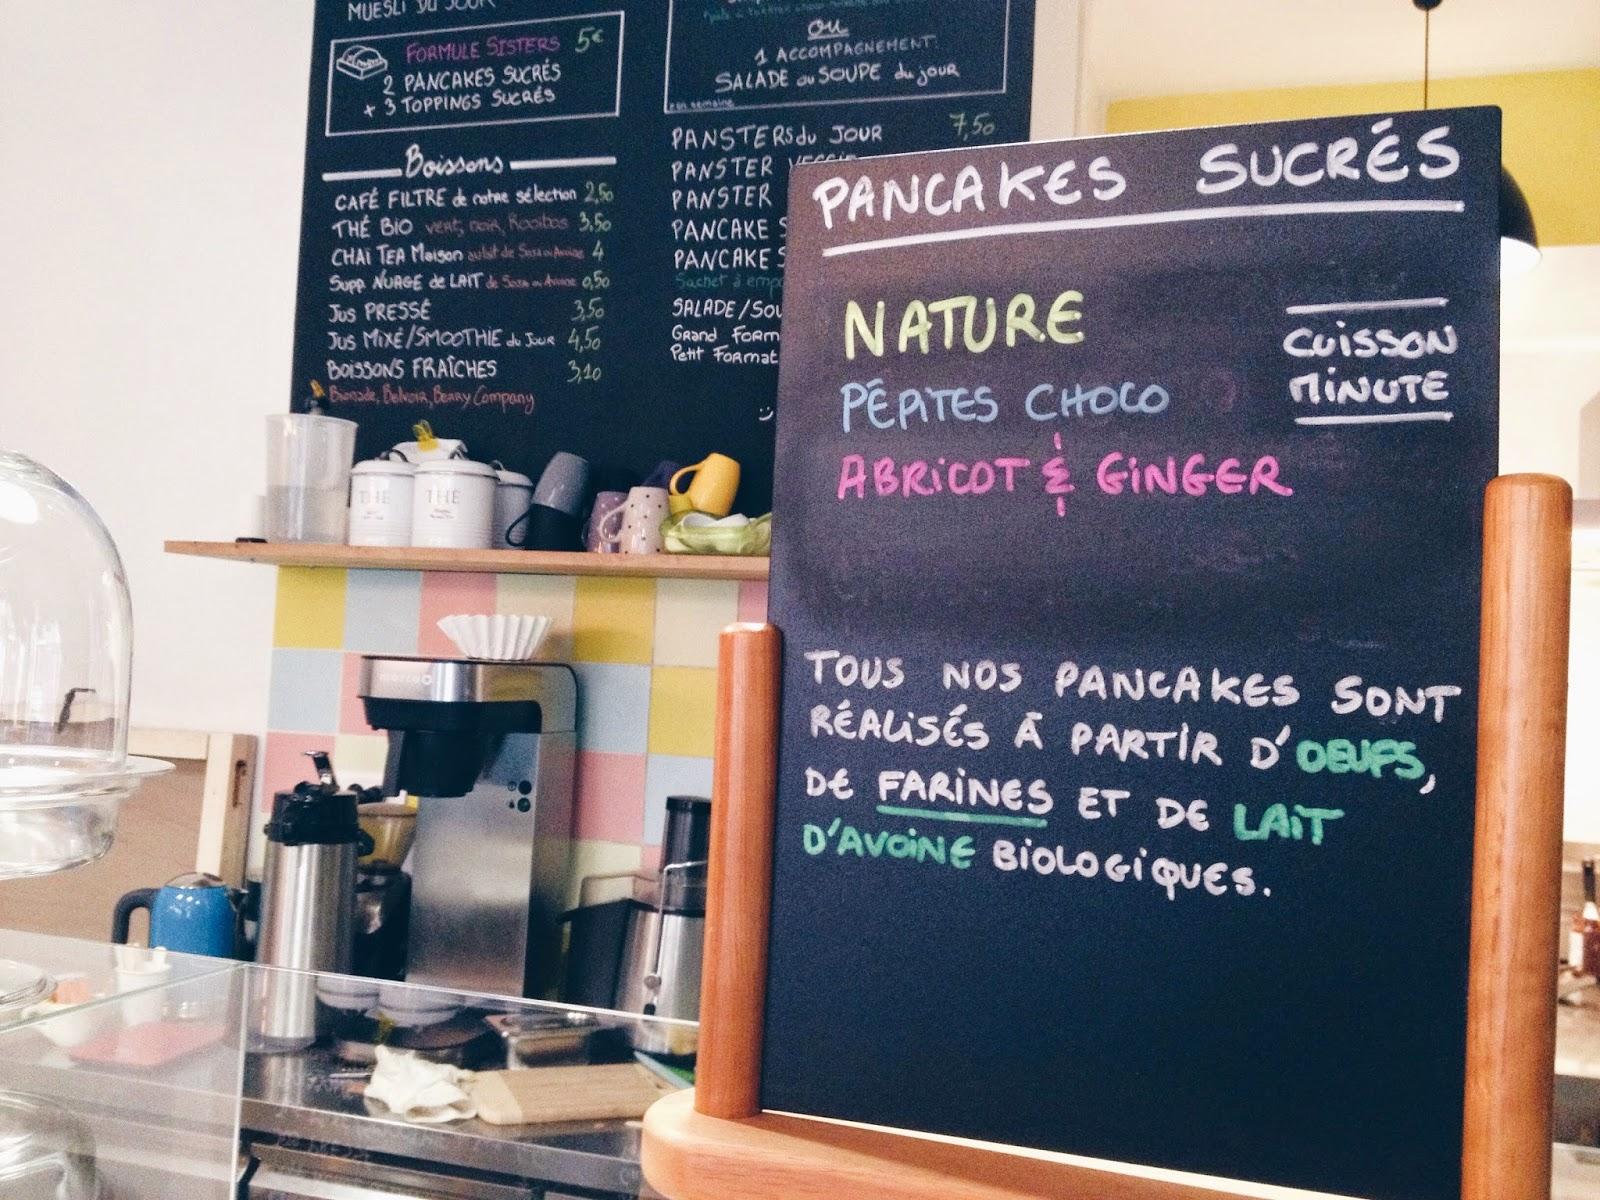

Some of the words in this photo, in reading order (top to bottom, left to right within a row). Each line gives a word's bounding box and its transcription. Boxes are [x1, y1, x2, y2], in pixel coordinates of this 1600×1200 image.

[405, 41, 481, 64] FORMULE
[485, 36, 561, 57] SISTERS
[383, 75, 396, 96] 2
[404, 68, 495, 94] PANCAKES
[503, 58, 562, 86] SUCRÉS
[714, 68, 789, 95] SALADE
[796, 73, 815, 88] ou
[817, 63, 882, 86] SOUPE
[893, 62, 914, 80] du
[385, 98, 397, 116] 3
[401, 94, 482, 115] TOPPINGS
[490, 86, 557, 109] SUCRÉS
[828, 124, 883, 145] JOUR
[948, 112, 996, 141] 7,50
[404, 143, 505, 179] Boissons
[672, 155, 774, 182] PANSTER
[812, 155, 1128, 229] PANCAKES
[1196, 117, 1463, 197] SUCRÉS
[334, 187, 381, 211] CAFÉ
[387, 187, 448, 209] FILTRE
[452, 187, 468, 207] de
[472, 189, 509, 205] notre
[516, 183, 577, 204] sélection
[672, 184, 773, 211] PANSTER
[331, 215, 371, 239] THÉ
[577, 211, 612, 232] 3,50
[672, 216, 770, 242] PANCAKE
[411, 242, 464, 264] Maison
[592, 239, 604, 261] 4
[673, 246, 771, 271] PANCAKE
[372, 268, 424, 291] NUAGE
[428, 272, 446, 289] de
[449, 271, 484, 289] LAIT
[581, 269, 611, 290] 0,50
[364, 298, 432, 322] PRESSÉ
[570, 296, 604, 321] 3,50
[506, 329, 522, 348] du
[566, 325, 602, 353] 4,50
[843, 289, 1086, 360] NATURE
[1282, 320, 1459, 359] CUISSON
[670, 343, 705, 362] Petit
[411, 356, 498, 379] FRAÎCHES
[566, 358, 602, 383] 3,10
[471, 384, 535, 414] Company
[1289, 366, 1452, 406] MINUTE
[840, 378, 1000, 433] PÉPITES
[1025, 382, 1170, 421] CHOCO
[836, 455, 1033, 501] ABRICOT
[1095, 450, 1294, 498] GINGER
[803, 649, 906, 691] TOUS
[941, 660, 1023, 693] NOS
[1054, 659, 1301, 708] PANCAKES
[1330, 674, 1463, 723] SONT
[808, 700, 990, 750] RÉALISÉS
[1070, 722, 1223, 767] PARTIR
[804, 766, 855, 802] DE
[876, 767, 1056, 814] FARINES
[1077, 786, 1131, 821] ET
[1156, 796, 1211, 832] DE
[1232, 802, 1346, 846] LAIT
[801, 816, 978, 870] D'AVOINE
